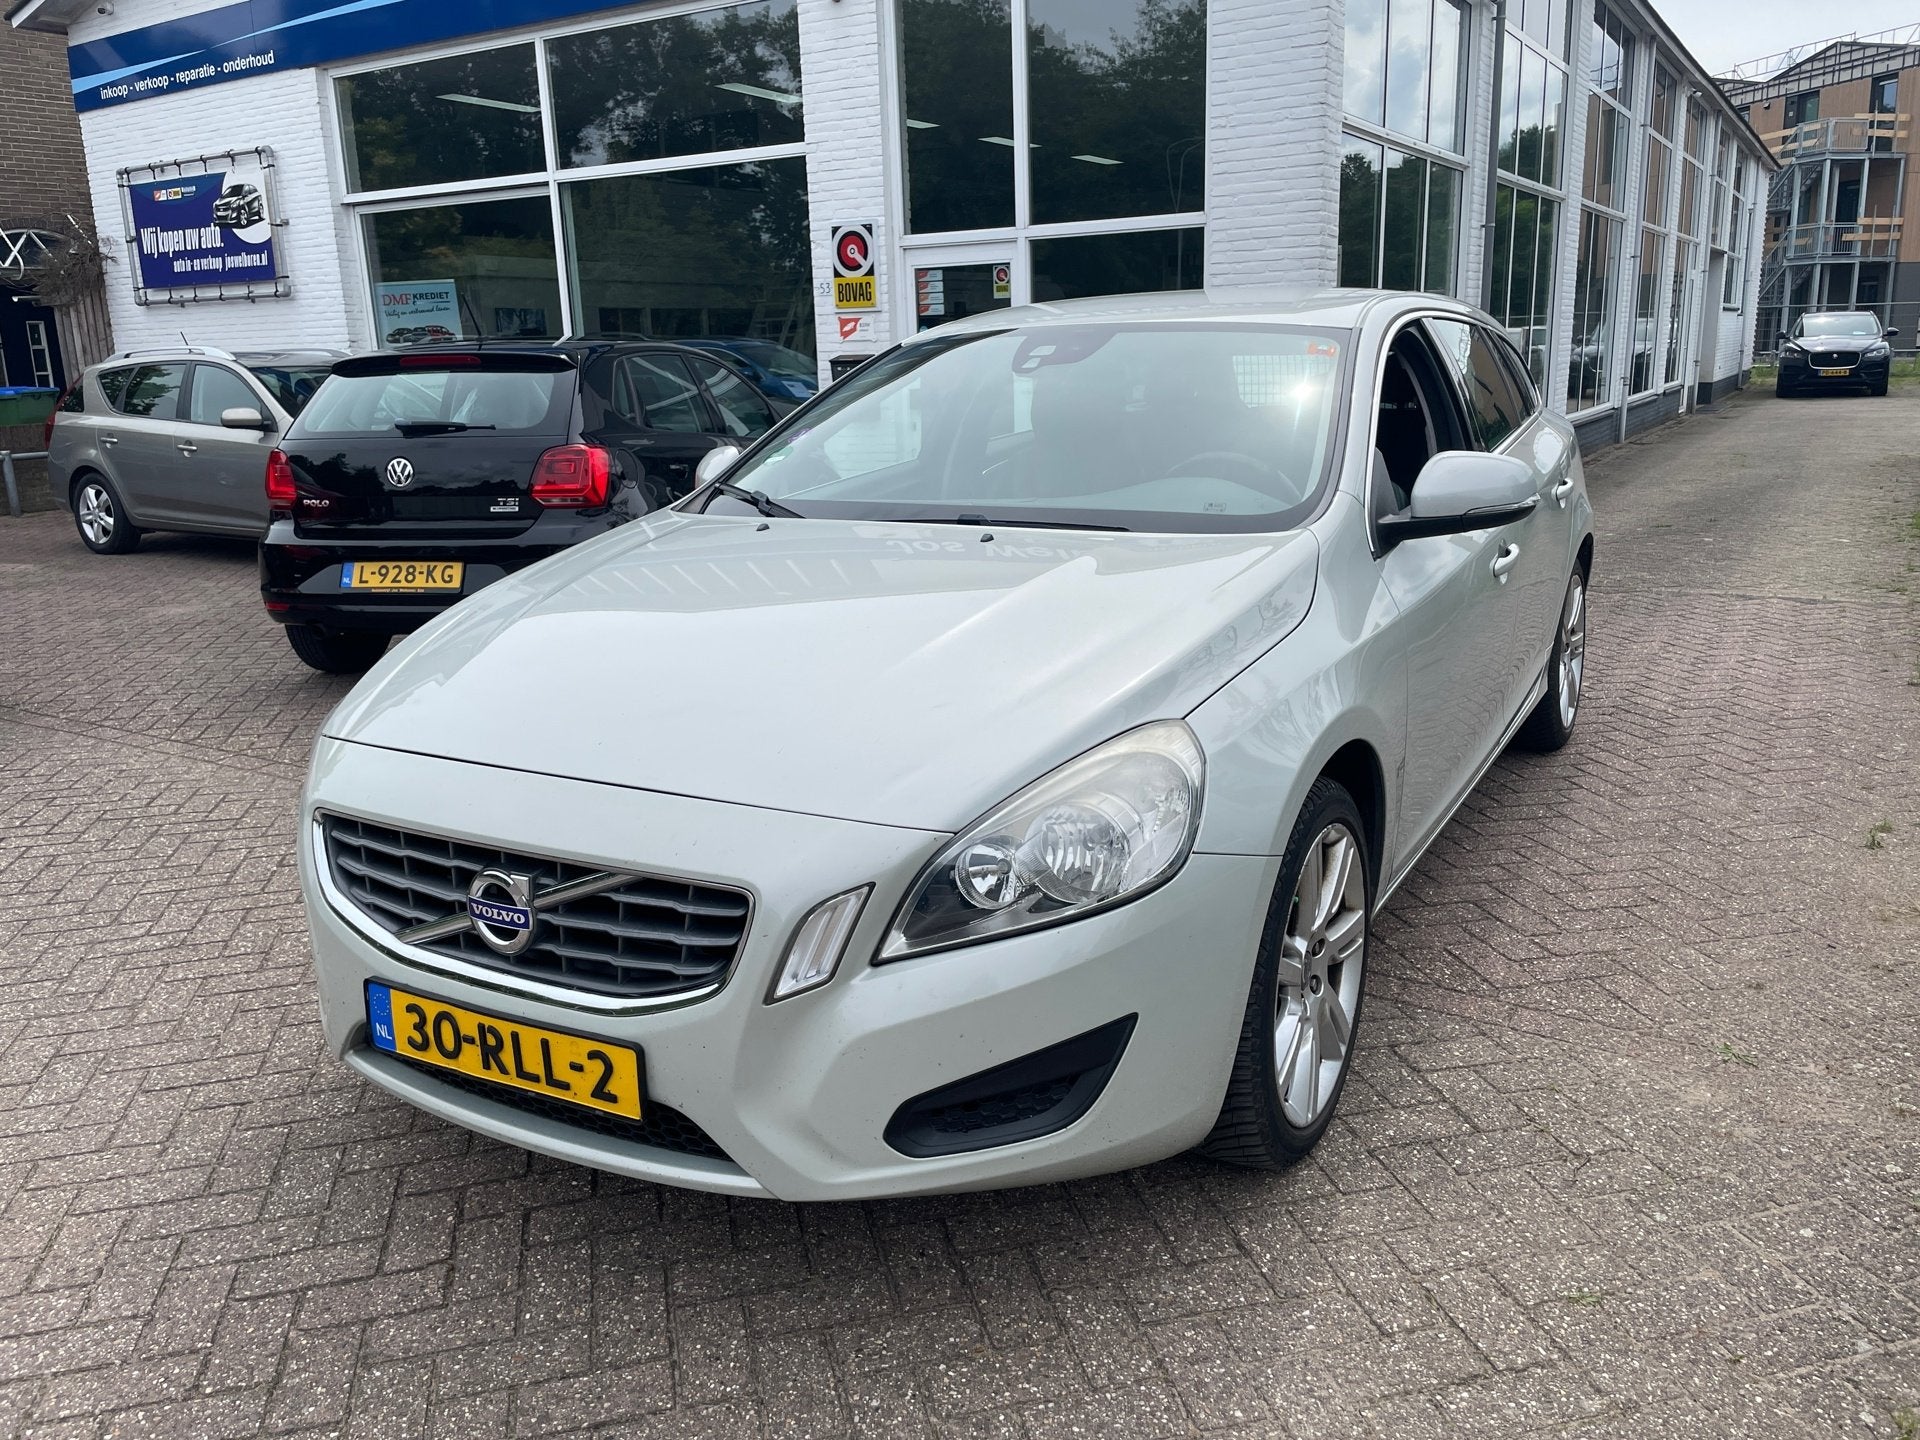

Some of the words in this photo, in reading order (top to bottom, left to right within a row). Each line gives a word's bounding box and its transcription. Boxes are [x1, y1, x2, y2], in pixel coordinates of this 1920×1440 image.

[100, 85, 129, 100] inkoop
[134, 74, 169, 92] verkoop
[176, 63, 216, 85] reparatie
[223, 50, 275, 74] onderhoud
[140, 227, 157, 259] Wij
[157, 226, 184, 258] kopen
[185, 228, 200, 250] uw
[200, 222, 224, 249] auto.
[382, 293, 412, 306] DMF
[412, 291, 450, 301] KREDIET
[837, 281, 873, 303] BOVAG
[303, 499, 330, 508] POLO
[358, 564, 454, 584] L-928-KG
[470, 902, 526, 924] VOLVO
[376, 1022, 393, 1040] NL
[405, 1002, 618, 1105] 30-RLL-2
